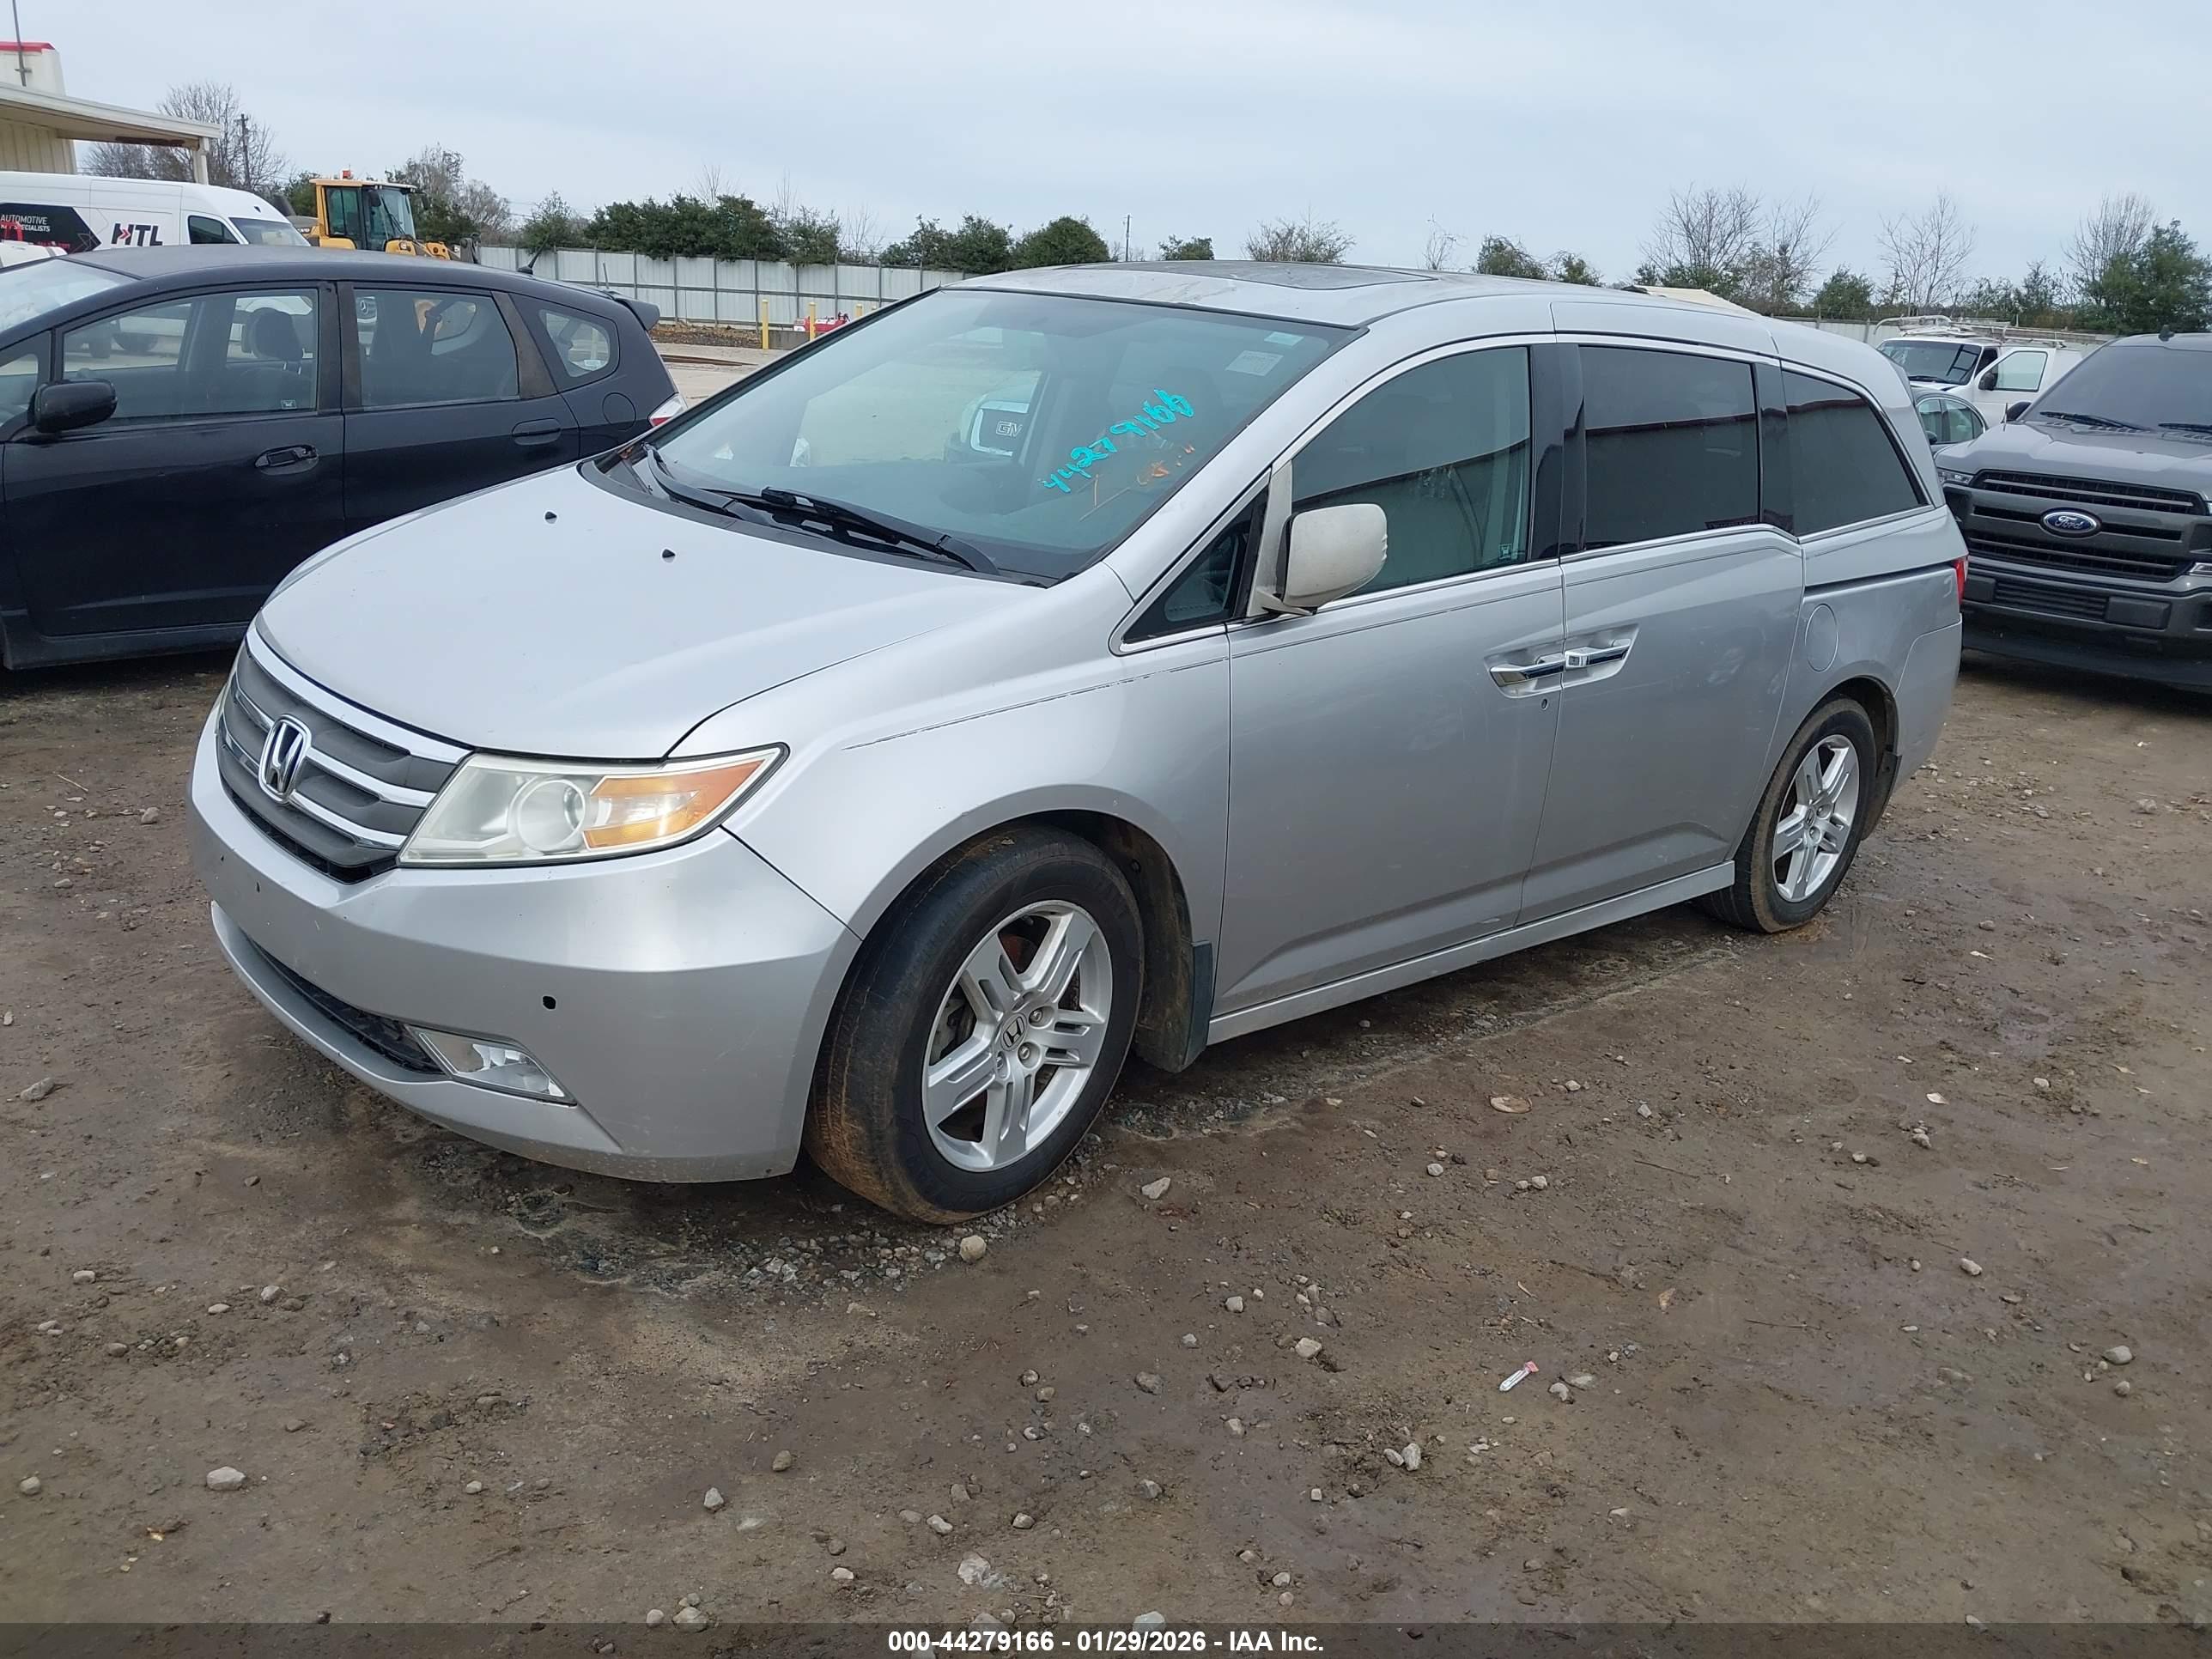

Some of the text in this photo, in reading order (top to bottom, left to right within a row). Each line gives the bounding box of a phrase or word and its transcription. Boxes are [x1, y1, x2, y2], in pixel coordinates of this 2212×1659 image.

[0, 214, 47, 225] AUTOMOTIVE
[111, 223, 163, 246] HTL
[2055, 515, 2083, 529] Ford
